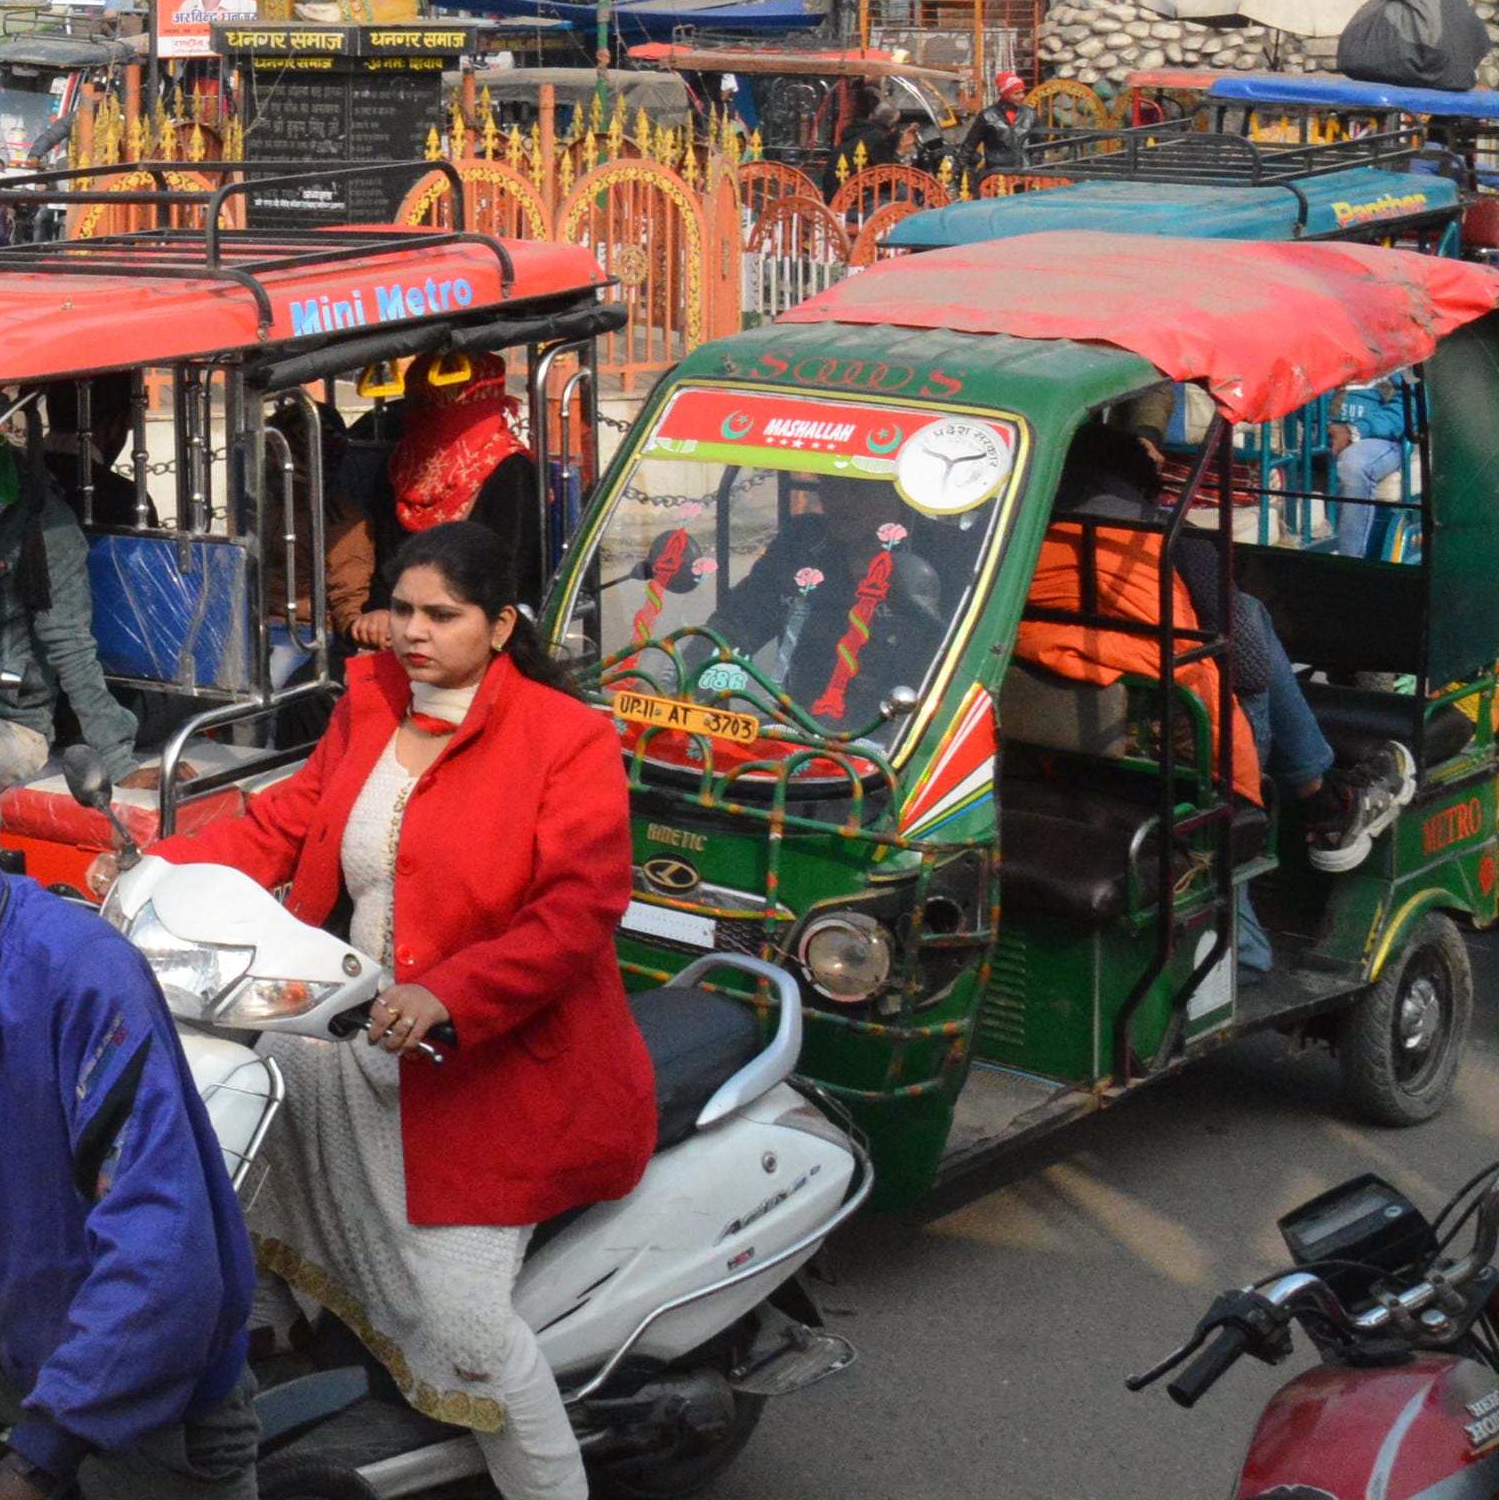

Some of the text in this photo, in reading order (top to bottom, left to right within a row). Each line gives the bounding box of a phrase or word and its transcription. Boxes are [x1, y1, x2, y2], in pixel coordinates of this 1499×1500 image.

[225, 31, 288, 49] धनगर
[289, 31, 345, 50] समाज
[369, 31, 466, 49] धनगर समाज
[1331, 192, 1427, 228] Panther
[290, 277, 473, 337] Mini Metro
[762, 417, 856, 443] MASHALLAH
[699, 661, 749, 691] 786
[667, 706, 693, 725] AT
[706, 711, 753, 741] 3703
[647, 822, 705, 852] KINETIC
[1422, 796, 1483, 856] METRO
